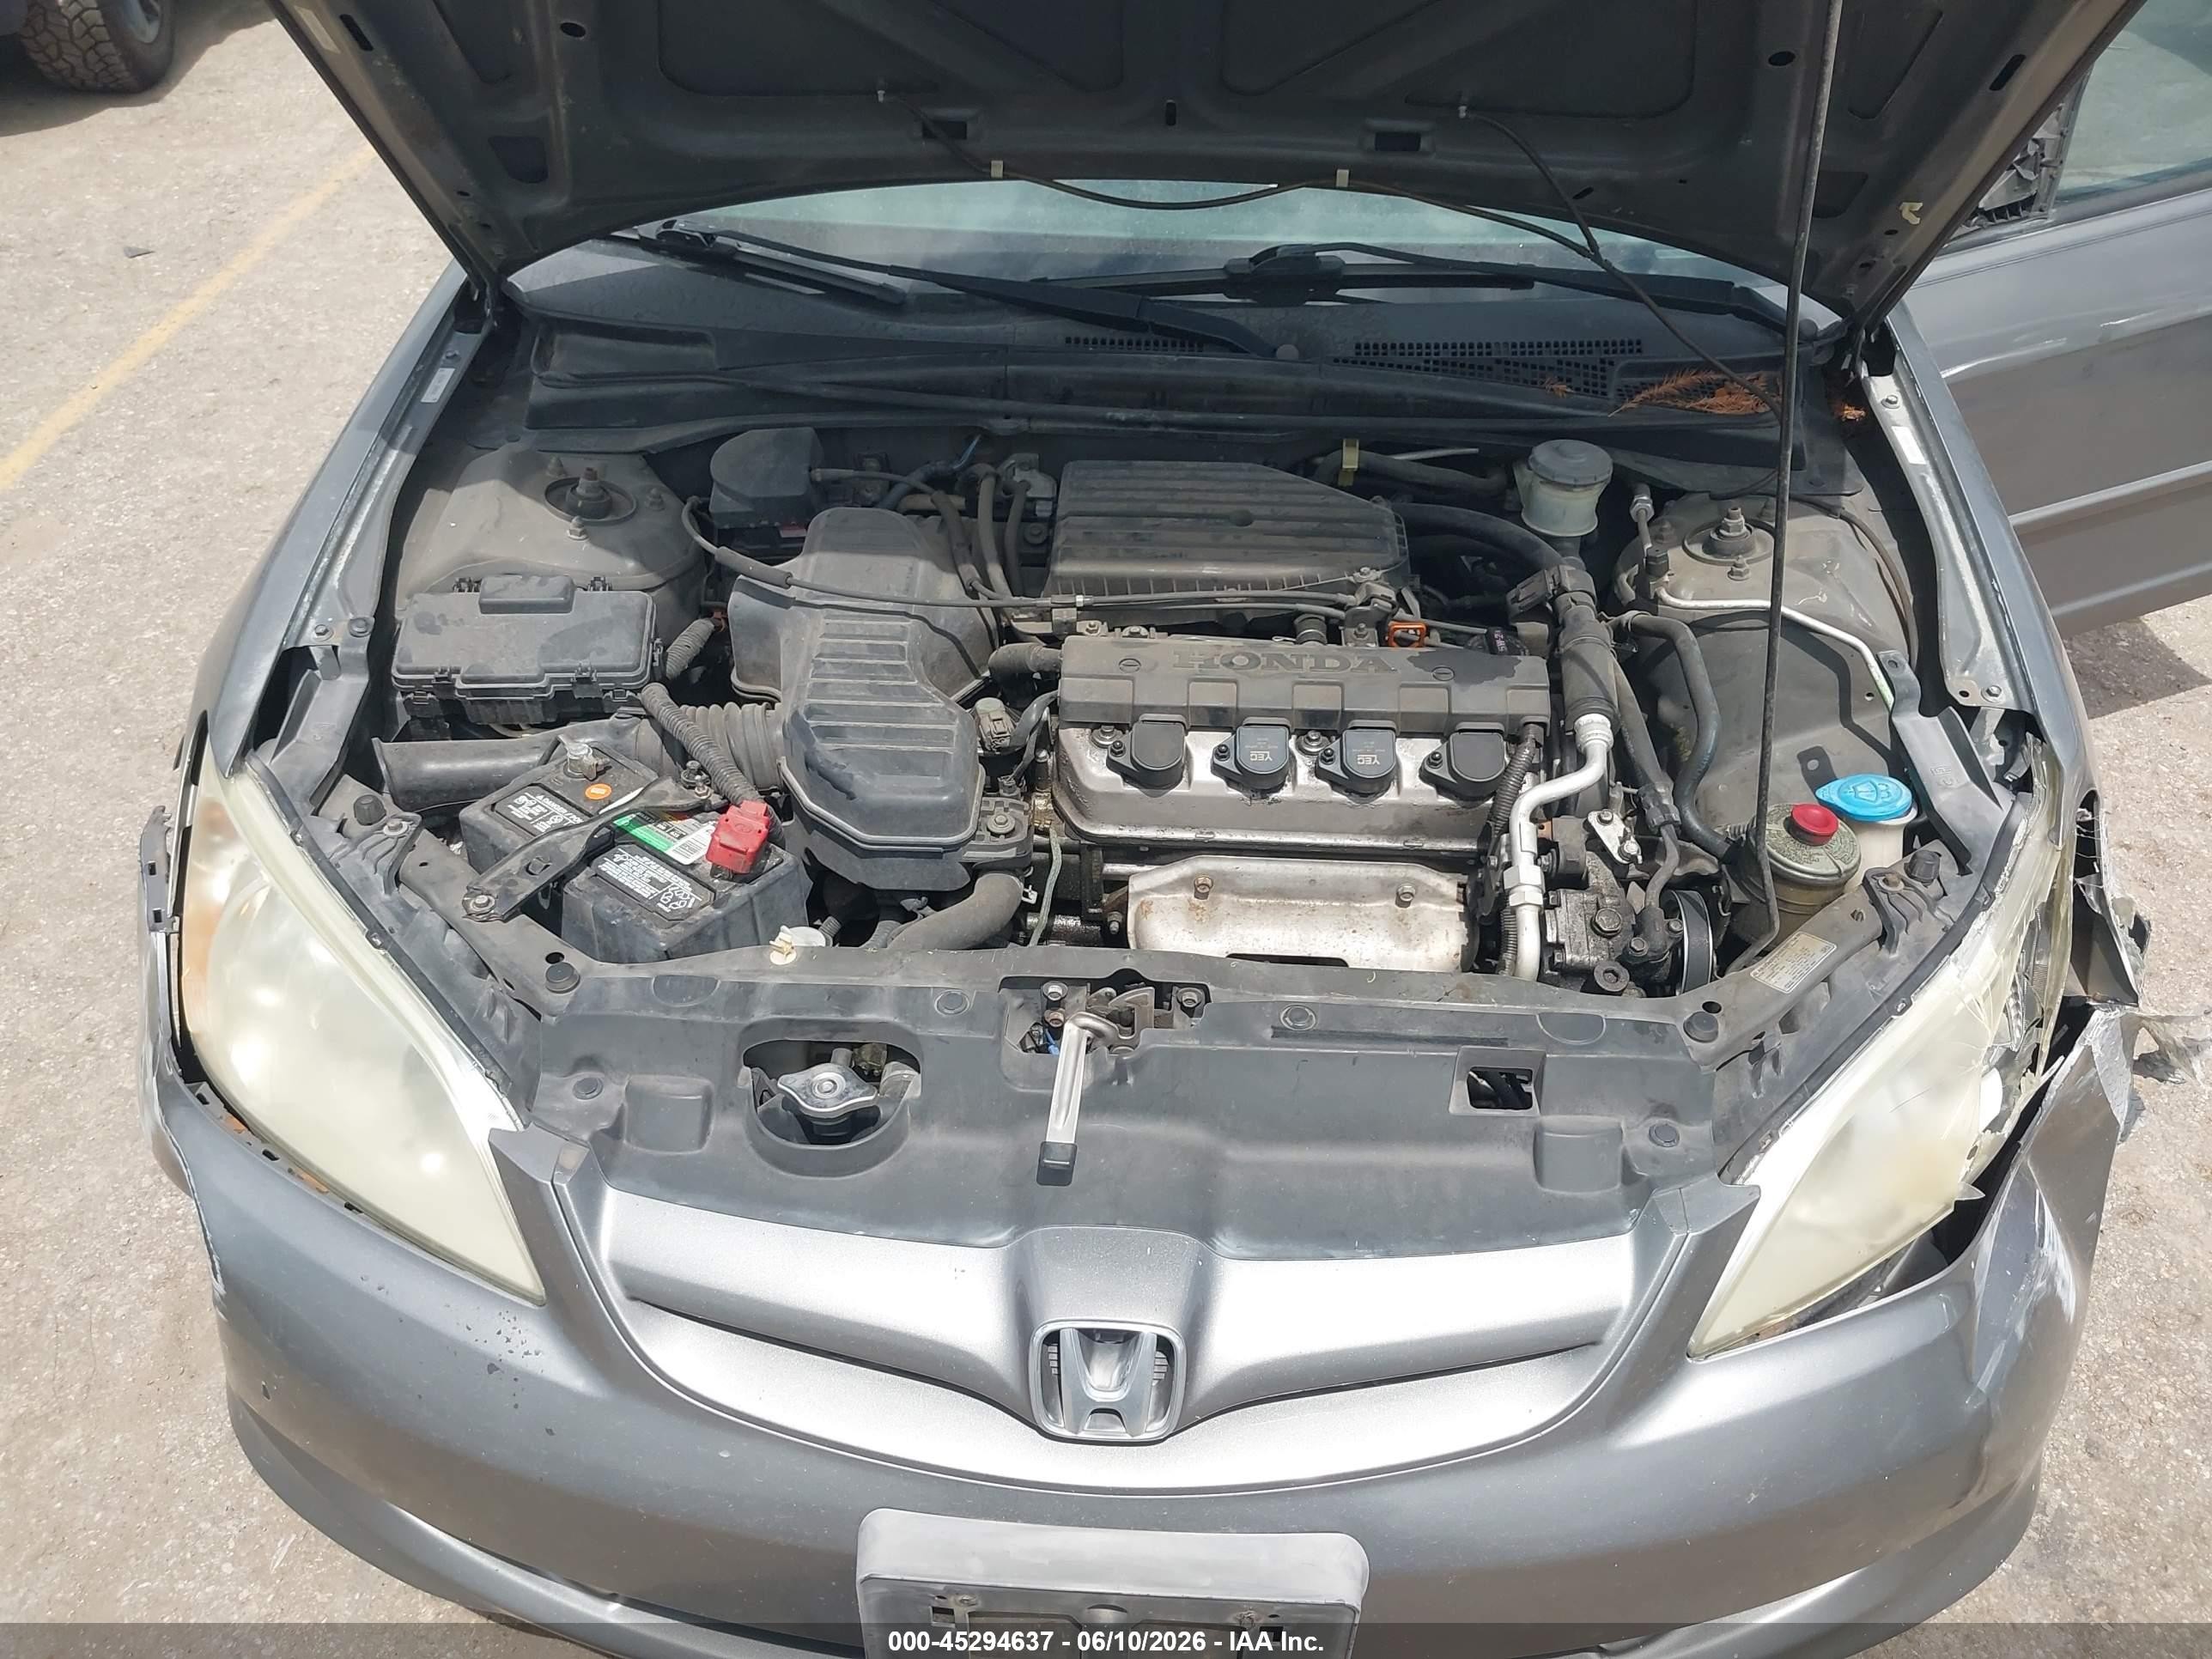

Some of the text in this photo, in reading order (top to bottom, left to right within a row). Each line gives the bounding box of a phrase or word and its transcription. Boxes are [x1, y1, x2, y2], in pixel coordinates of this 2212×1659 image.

[1173, 651, 1399, 674] HONDA
[1249, 750, 1273, 762] YEC
[1357, 754, 1380, 765] YEC
[542, 798, 568, 814] DANGER
